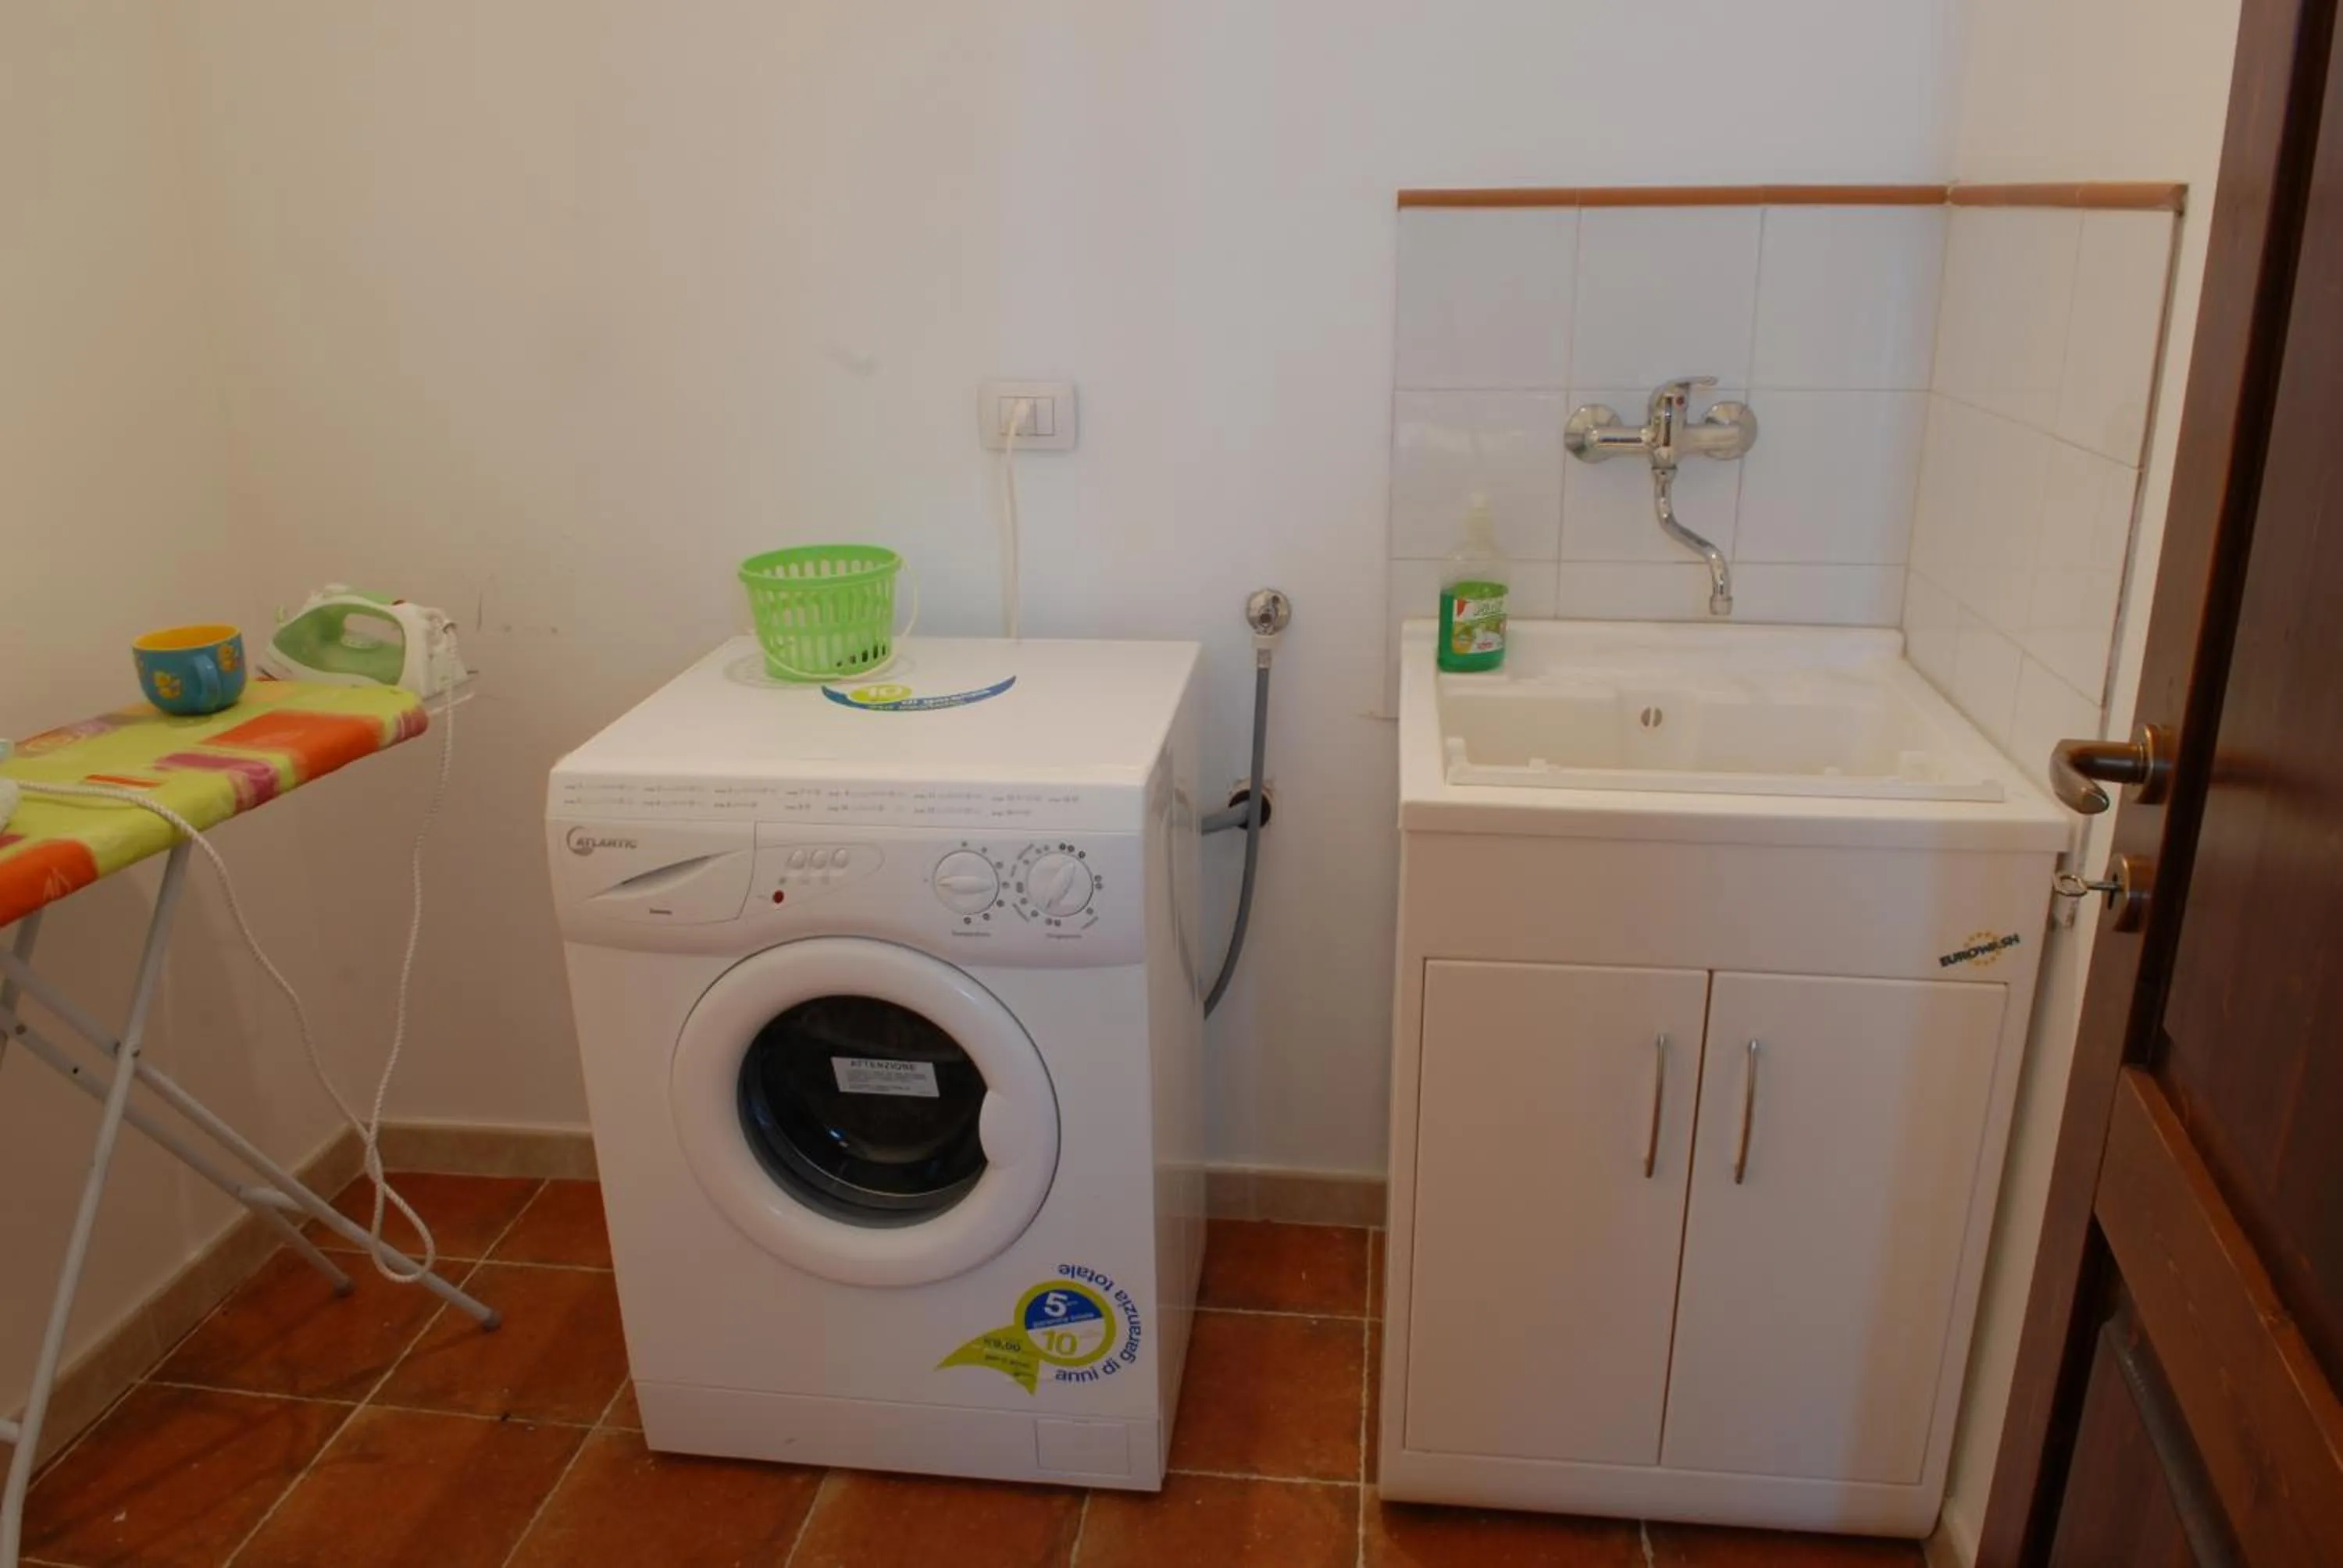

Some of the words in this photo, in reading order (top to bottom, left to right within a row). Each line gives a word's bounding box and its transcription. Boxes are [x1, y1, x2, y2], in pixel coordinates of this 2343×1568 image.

[576, 837, 638, 849] ATLANTIC
[1057, 1263, 1114, 1291] totale
[1043, 1292, 1068, 1317] 5
[1114, 1289, 1142, 1363] garanzia
[1042, 1330, 1077, 1356] 10
[1055, 1367, 1099, 1382] anni
[1101, 1357, 1120, 1375] di
